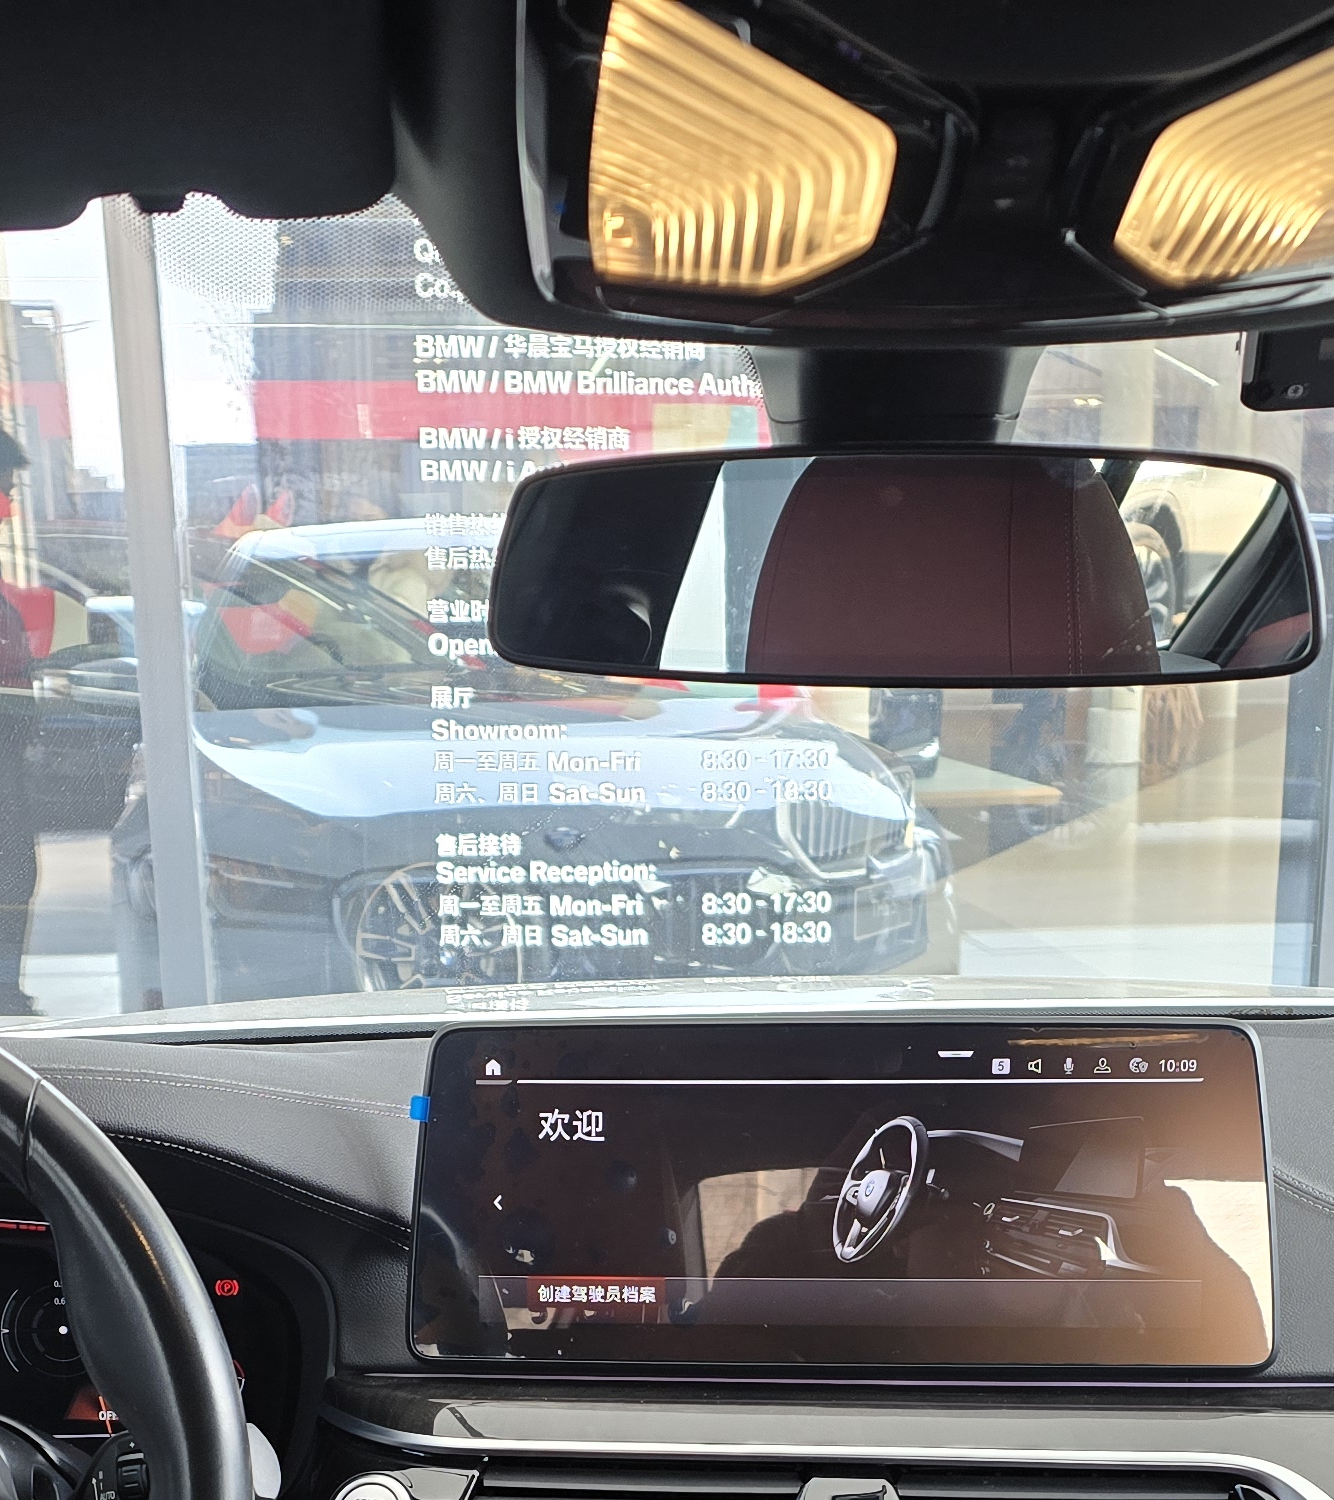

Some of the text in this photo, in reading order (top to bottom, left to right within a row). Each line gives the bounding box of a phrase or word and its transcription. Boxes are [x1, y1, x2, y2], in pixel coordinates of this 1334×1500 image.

[416, 334, 705, 361] BMW / 华晨宝马授权经销商
[417, 370, 486, 394] BMW
[489, 370, 497, 393] /
[504, 371, 571, 394] BMW
[577, 369, 694, 396] Brilliance
[419, 426, 630, 451] BMW / i 授权经销商
[420, 460, 488, 482] BMW
[507, 460, 515, 482] i
[431, 685, 474, 709] 展厅
[431, 719, 567, 741] Showroom:
[434, 751, 540, 772] 周一至周五
[548, 751, 641, 772] Mon-Fri
[701, 751, 751, 772] 8:30
[772, 750, 830, 770] 17:30
[549, 782, 647, 804] Sat-Sun
[701, 782, 751, 802] 8:30
[771, 781, 832, 801] 18:30
[436, 833, 521, 857] 售后接待
[436, 859, 657, 887] Service Reception:
[439, 894, 544, 917] 周一至周五
[550, 894, 644, 917] Mon-Fri
[702, 893, 752, 915] 8:30
[771, 891, 832, 913] 17:30
[551, 924, 649, 947] Sat-Sun
[702, 923, 752, 945] 8:30
[771, 921, 832, 943] 18:30
[1159, 1058, 1197, 1073] 10:09
[538, 1109, 605, 1142] 欢迎
[537, 1285, 657, 1303] 创建驾驶员档案
